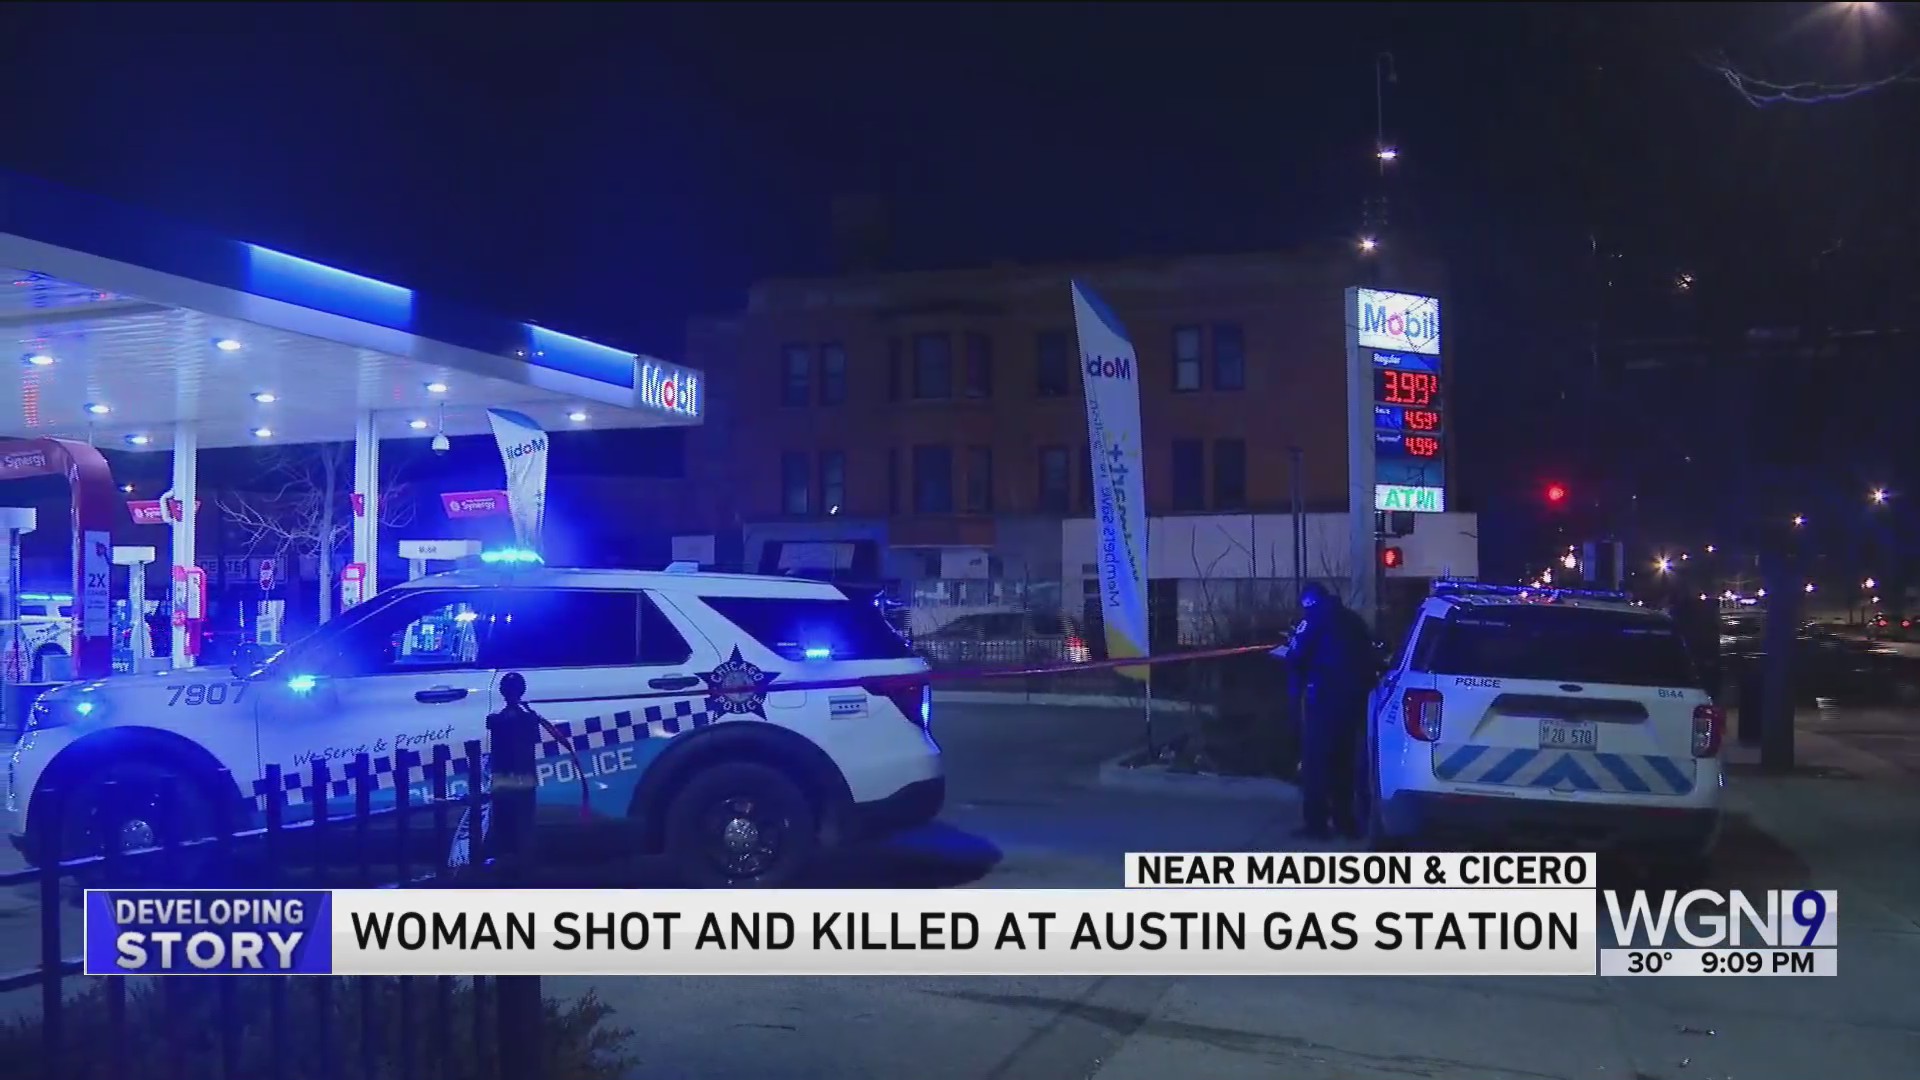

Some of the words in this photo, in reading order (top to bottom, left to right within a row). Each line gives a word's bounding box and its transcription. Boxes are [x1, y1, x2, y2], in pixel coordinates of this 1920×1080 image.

[1364, 302, 1436, 339] Mobil
[642, 364, 698, 416] Mobil
[1384, 488, 1435, 509] ATM
[88, 573, 106, 588] 2X
[710, 661, 764, 683] CHICAGO
[1455, 677, 1502, 689] POLICE
[166, 681, 249, 706] 7907
[714, 694, 764, 713] POLICE
[294, 750, 321, 767] We
[374, 738, 388, 753] &
[395, 725, 455, 751] Protect
[536, 747, 637, 787] POLICE
